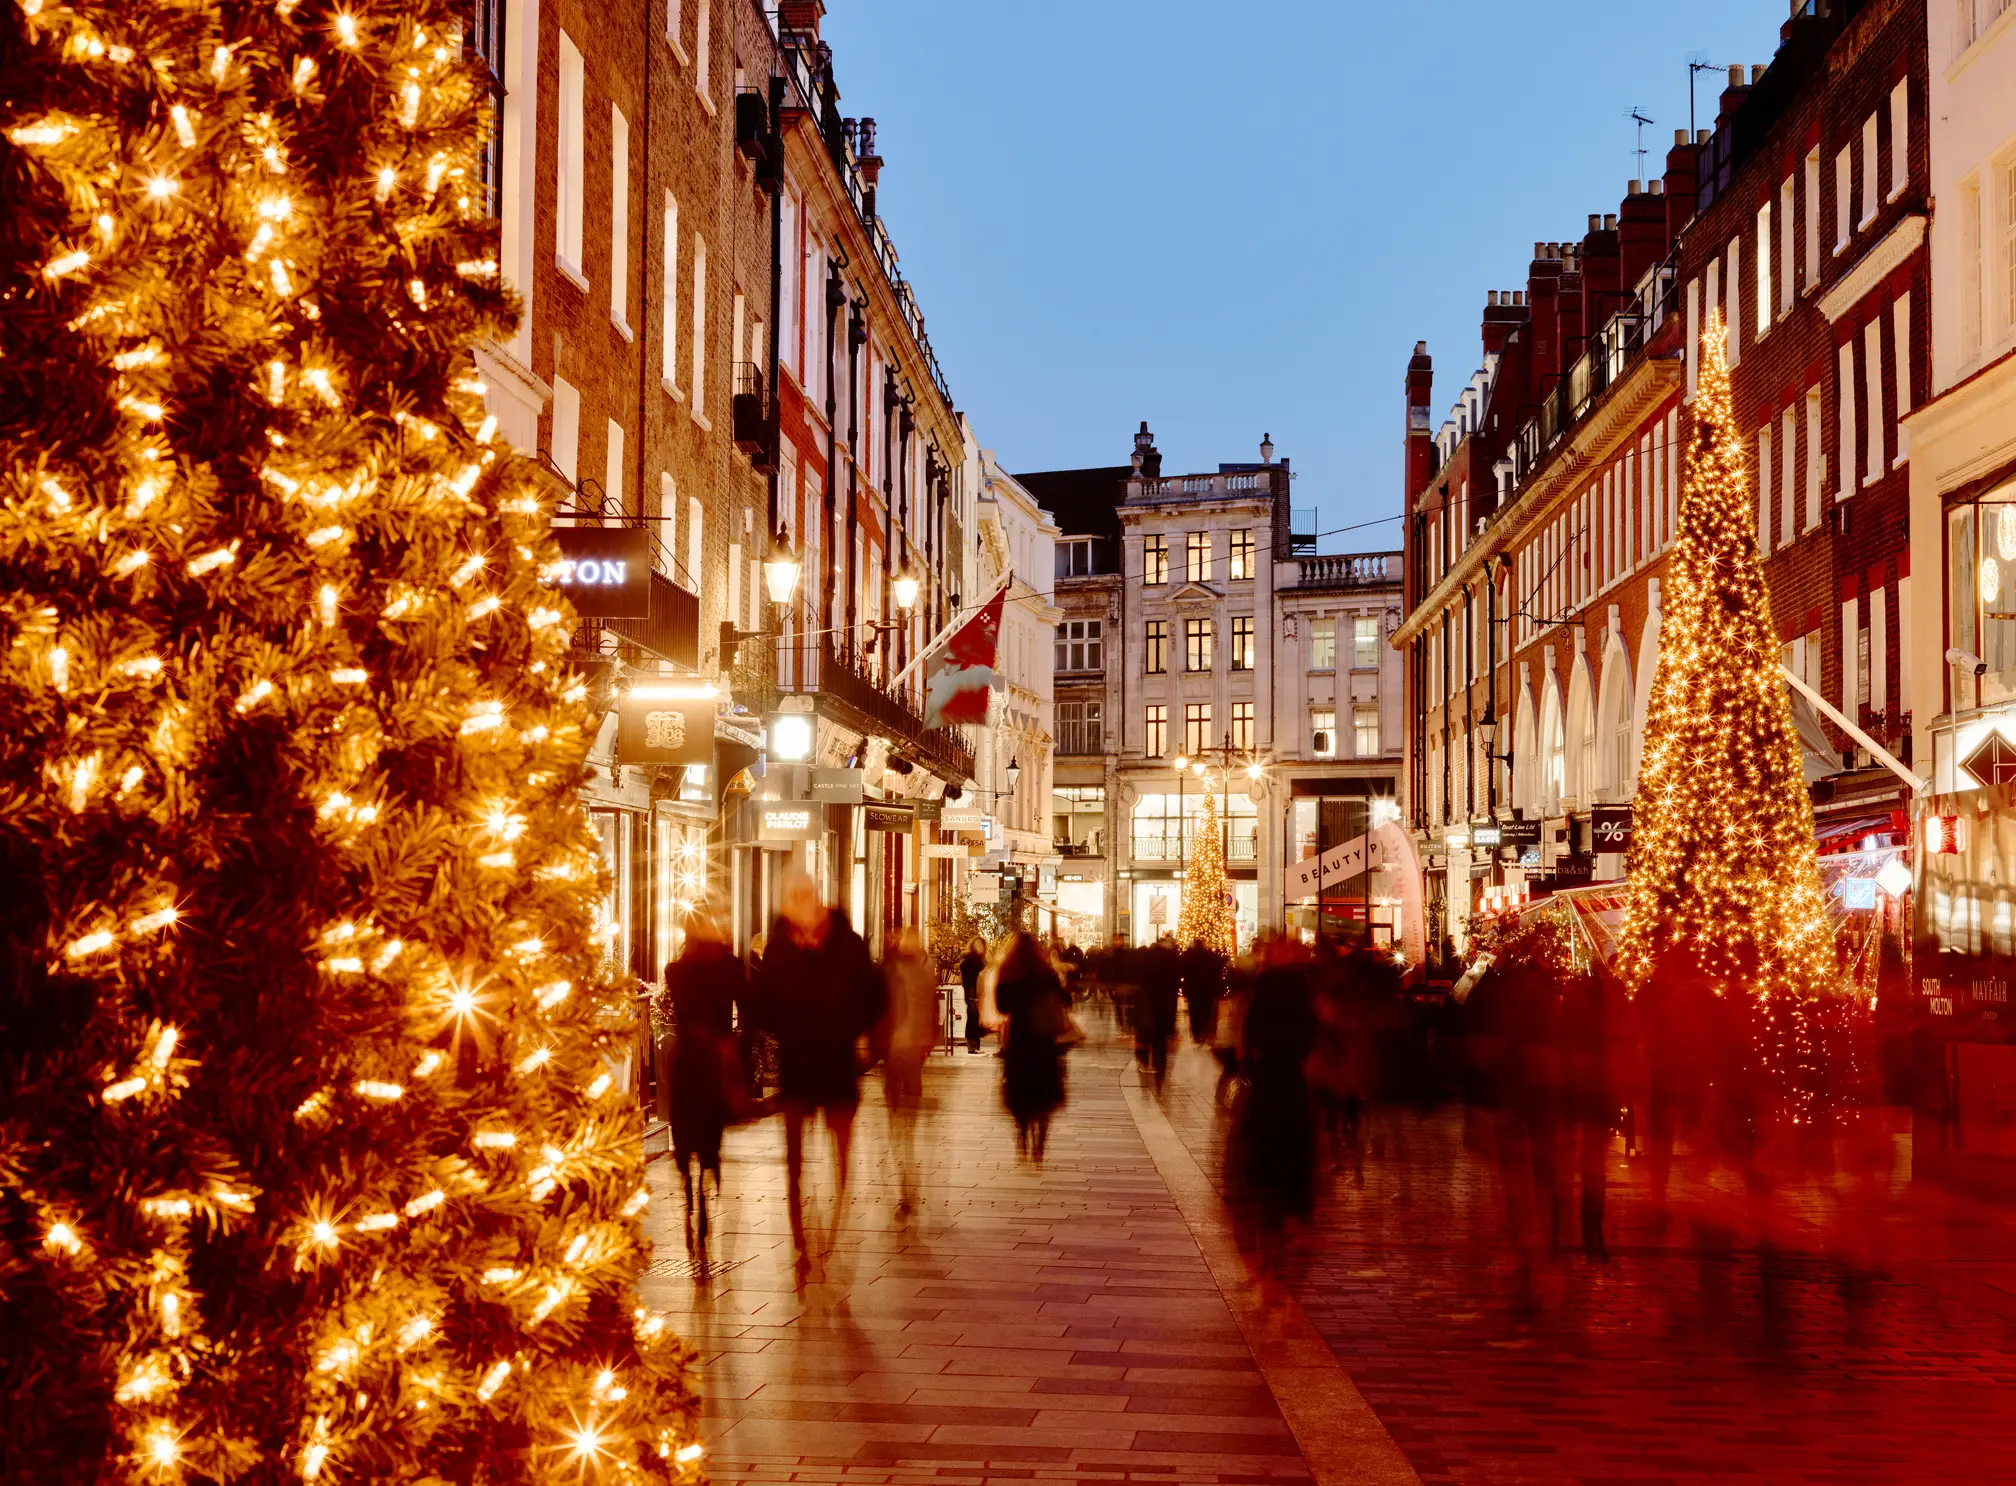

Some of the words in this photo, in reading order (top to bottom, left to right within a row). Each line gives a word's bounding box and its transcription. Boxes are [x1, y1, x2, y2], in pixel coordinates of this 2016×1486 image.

[556, 560, 626, 584] TON
[765, 812, 809, 821] CLAUDIE
[766, 820, 809, 829] PIERLOT
[869, 812, 909, 823] SLOWEAR
[1300, 849, 1361, 884] BEAUTY
[1557, 865, 1590, 875] ba&sh
[1922, 978, 1940, 996] SOUTH
[1972, 980, 2007, 1002] MAYFAIR
[1930, 997, 1953, 1016] MOLTON
